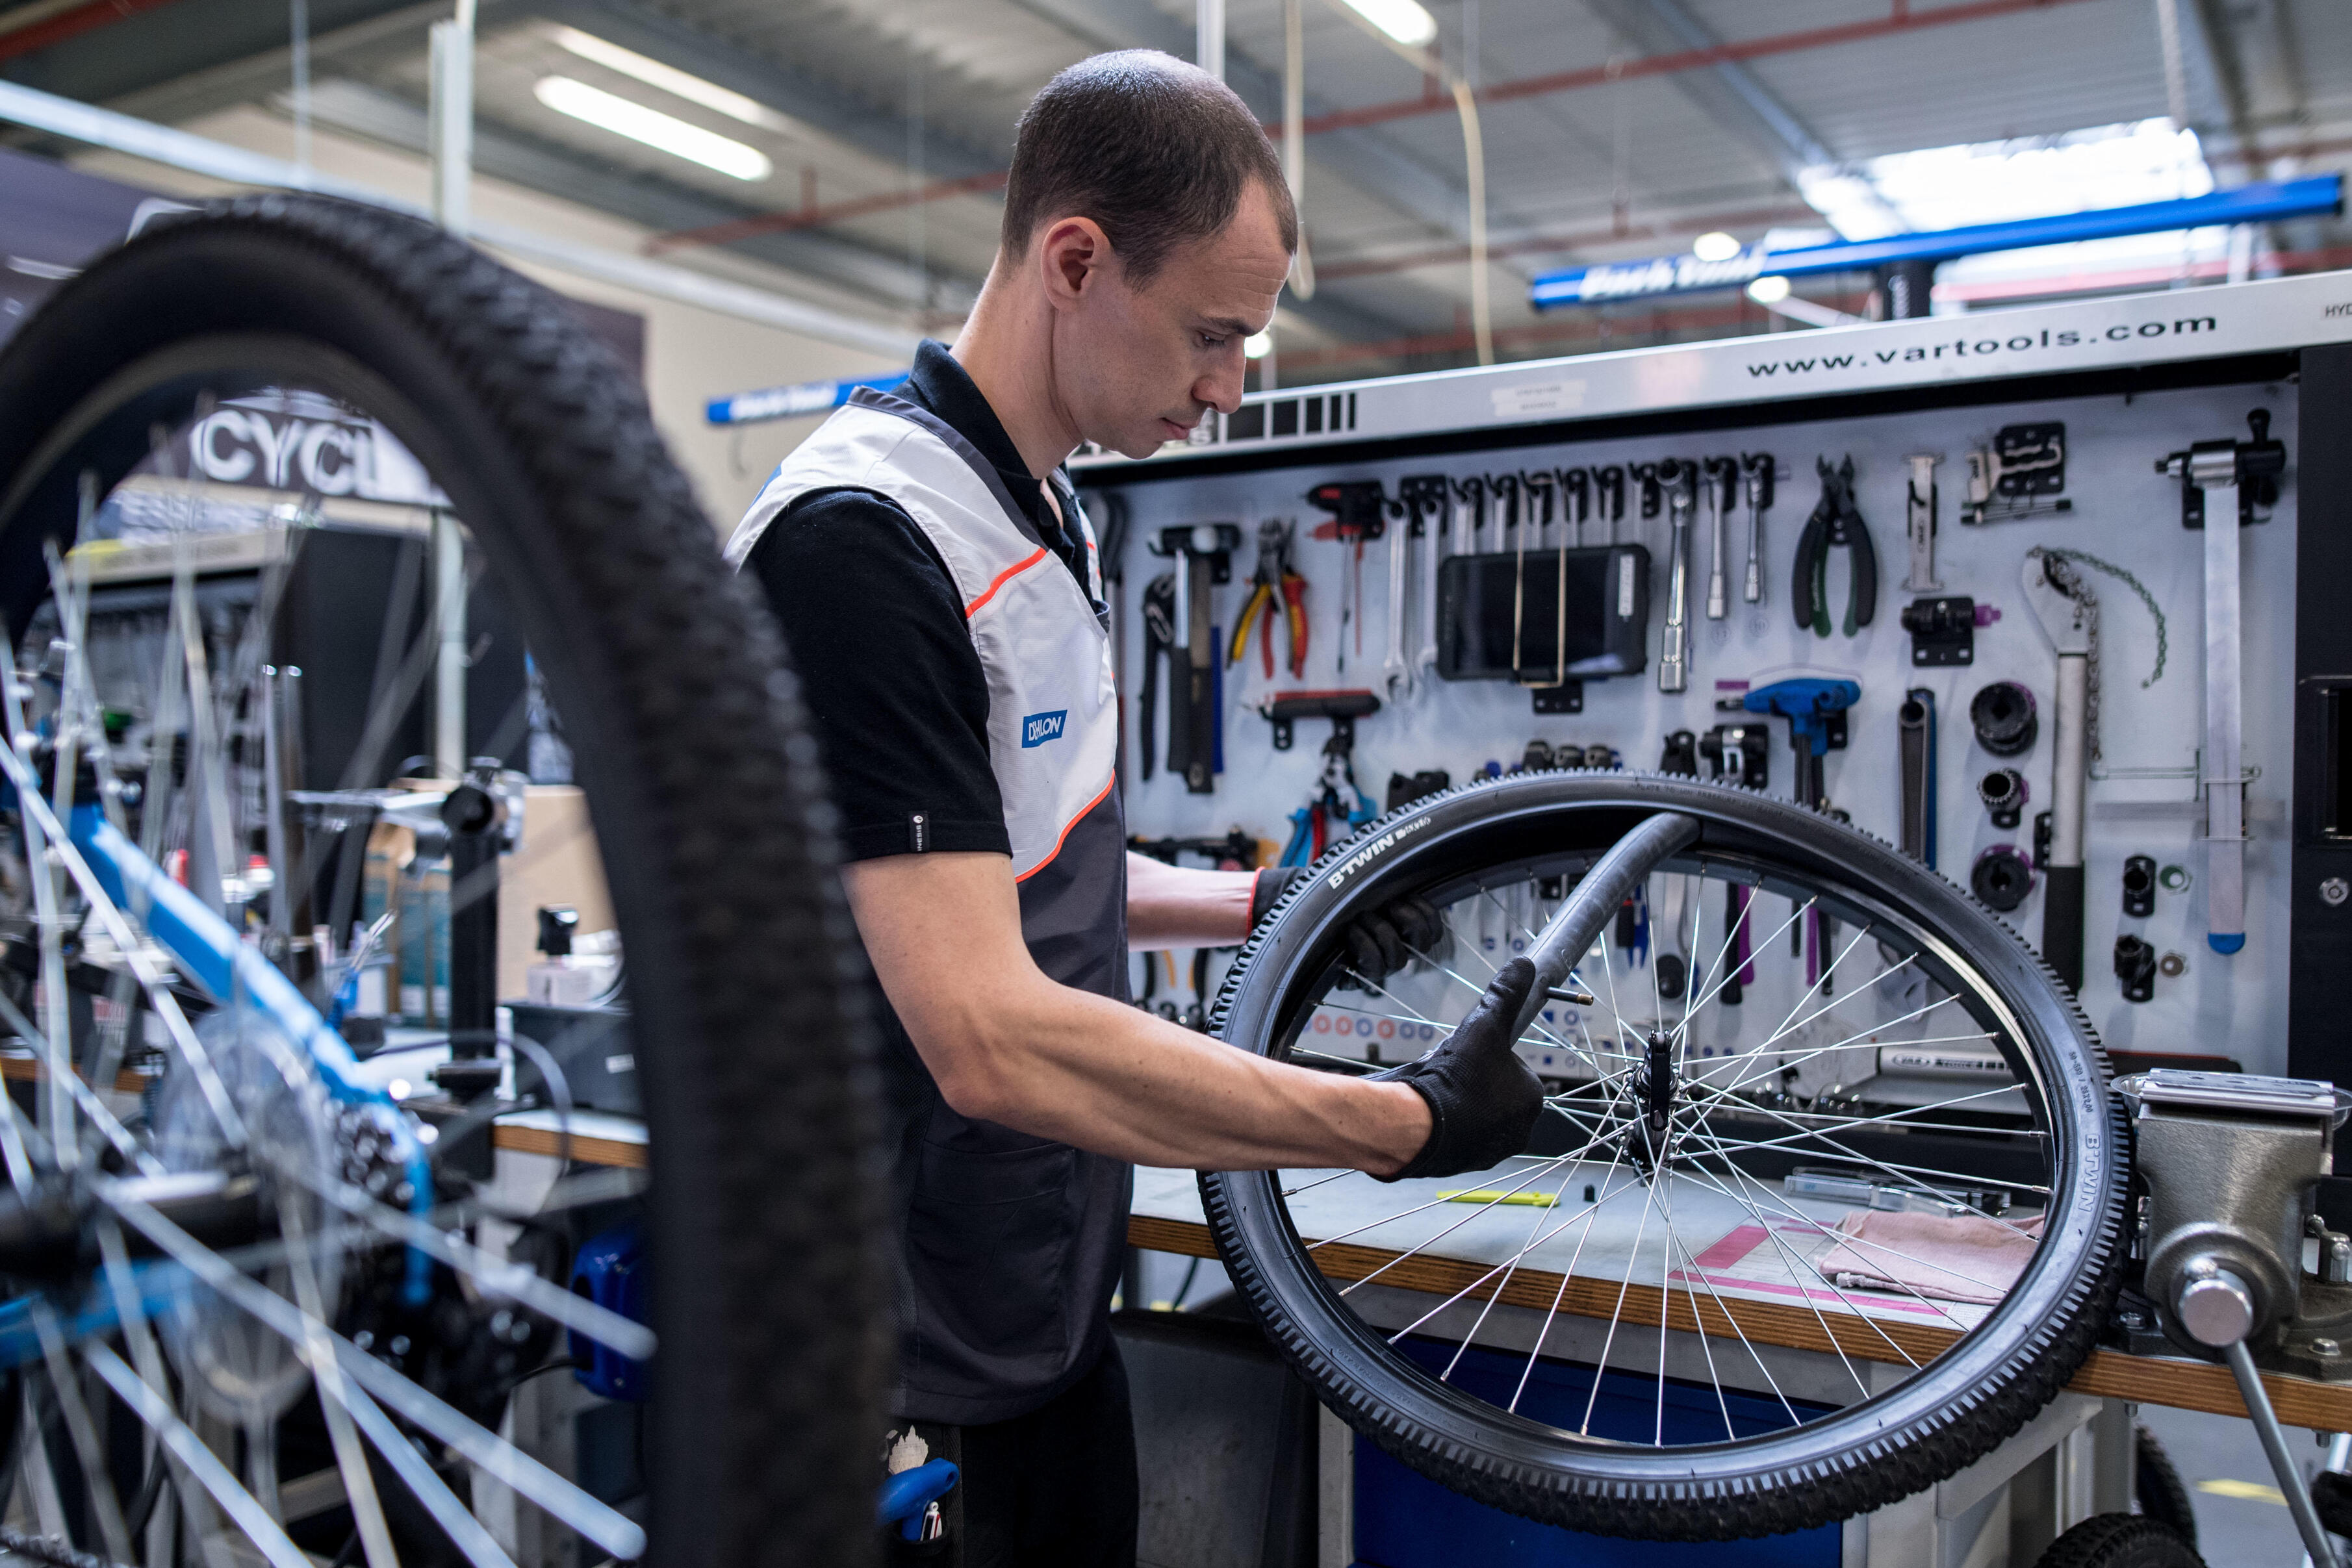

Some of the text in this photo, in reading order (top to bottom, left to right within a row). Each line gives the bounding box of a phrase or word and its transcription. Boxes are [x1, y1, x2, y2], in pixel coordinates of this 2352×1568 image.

[1747, 314, 2217, 379] www.vartools.com
[1327, 833, 1395, 890] B'TWIN
[2078, 1133, 2101, 1213] B'TWIN
